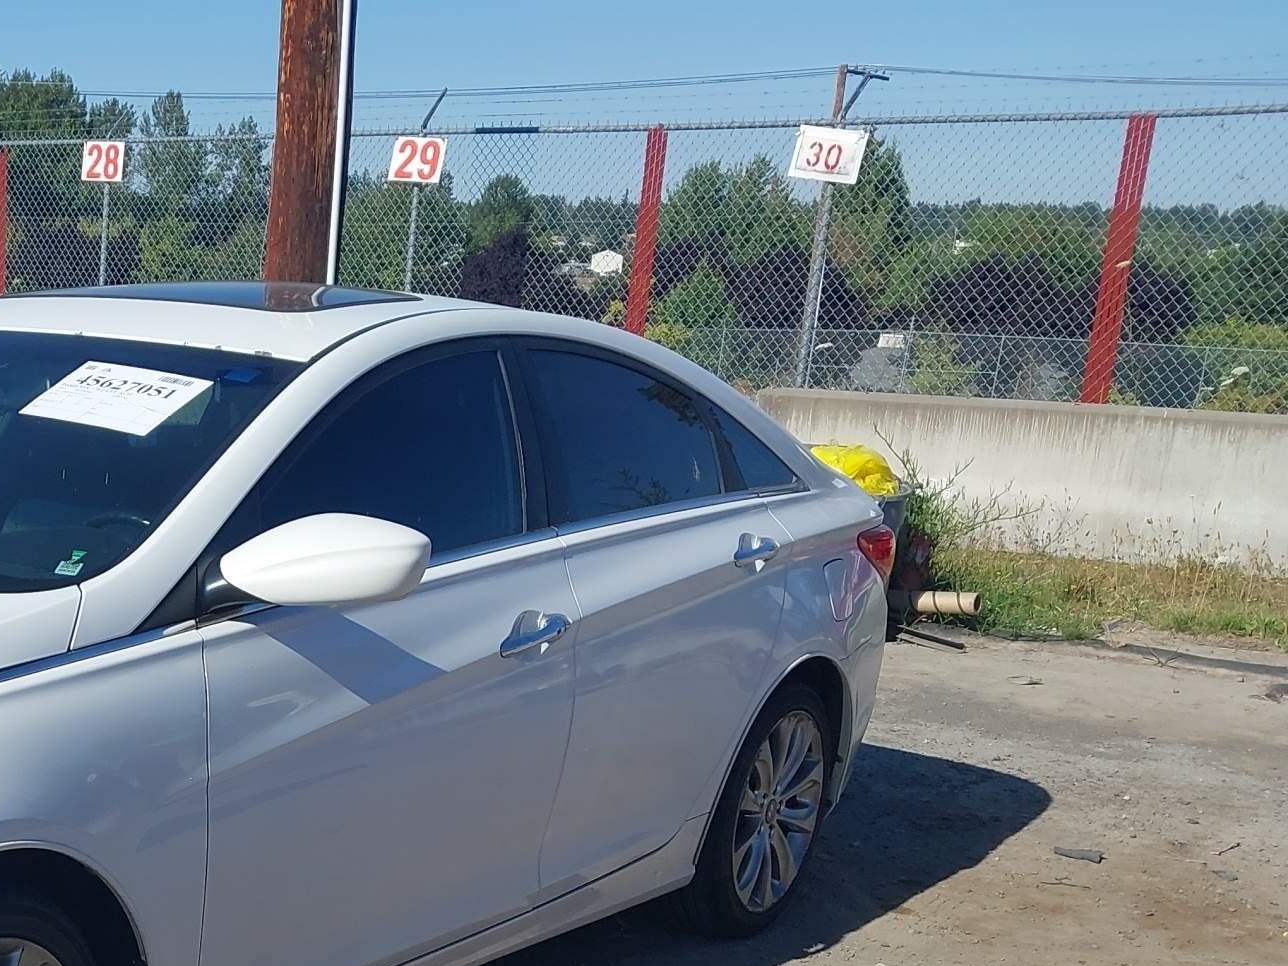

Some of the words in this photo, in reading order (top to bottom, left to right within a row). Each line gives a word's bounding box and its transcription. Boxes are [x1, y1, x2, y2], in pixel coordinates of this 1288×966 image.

[86, 143, 120, 180] 28
[394, 139, 440, 180] 29
[806, 141, 843, 171] 30
[75, 374, 178, 400] 45627051
